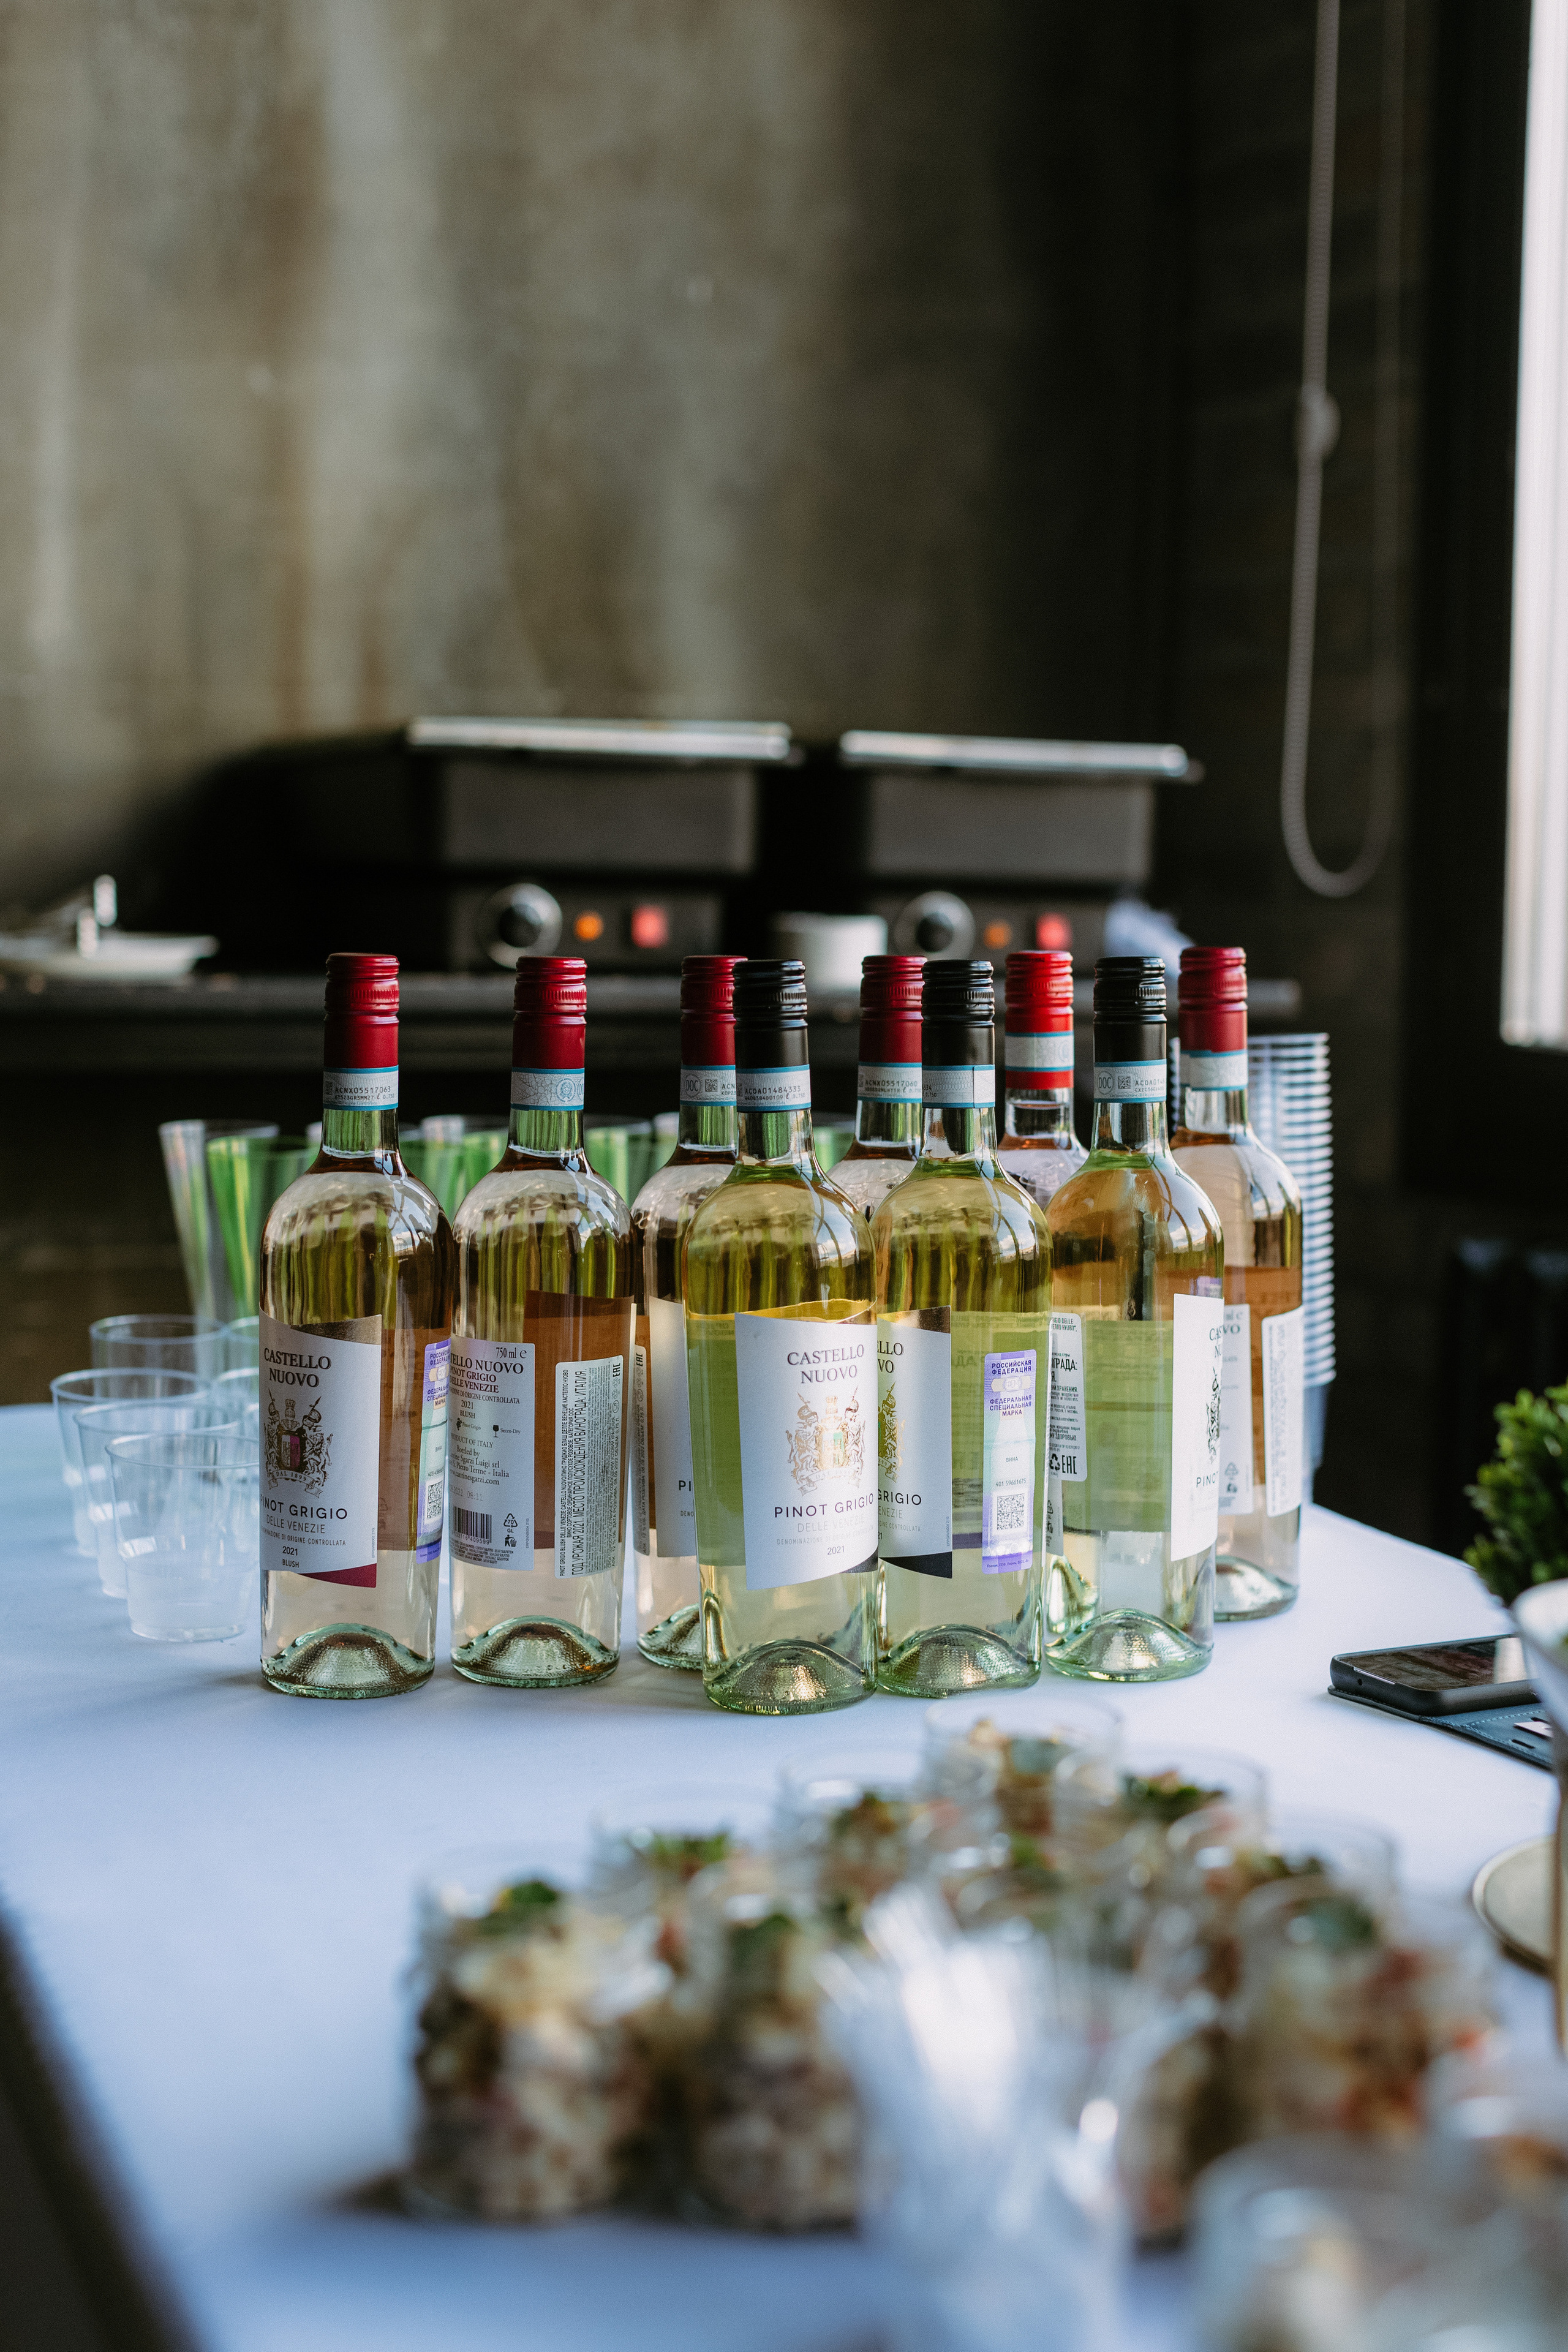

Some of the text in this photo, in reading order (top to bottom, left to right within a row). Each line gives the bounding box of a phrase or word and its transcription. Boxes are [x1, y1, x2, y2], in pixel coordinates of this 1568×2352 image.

[686, 1080, 698, 1091] DOC
[1098, 1077, 1112, 1089] DOC
[1223, 1324, 1241, 1335] VO
[264, 1347, 331, 1370] CASTELLO
[496, 1347, 507, 1359] 750
[508, 1347, 517, 1359] ml
[787, 1344, 864, 1366] CASTELLO
[451, 1352, 524, 1374] TELLO NUOVO
[877, 1359, 894, 1373] VO
[992, 1360, 1031, 1370] РОССИЙСКАЯ
[1052, 1357, 1077, 1373] ГРАДА:
[467, 1370, 497, 1383] GRIGIO
[801, 1365, 858, 1384] NUOVO
[992, 1365, 1031, 1376] ФЕДЕРАЦИЯ
[270, 1367, 319, 1388] NUOVO
[464, 1380, 499, 1393] VENEZIE
[464, 1391, 482, 1401] ORIGINE
[482, 1394, 521, 1404] CONTROLLATA
[990, 1395, 1032, 1405] ФЕДЕРАЛЬНАЯ
[461, 1400, 474, 1409] 2021
[990, 1401, 1032, 1411] СПЕЦИАЛЬНАЯ
[460, 1410, 476, 1419] BLUSH
[469, 1438, 477, 1446] OF
[477, 1439, 494, 1449] ITALY
[456, 1444, 480, 1459] Bottled by
[460, 1454, 474, 1464] Sgarzi
[475, 1457, 491, 1469] Luigi
[291, 1472, 307, 1482] 1899
[469, 1464, 487, 1476] Terme
[492, 1469, 510, 1478] Italia
[571, 1369, 589, 1575] ГОД УРОЖАЯ 2021. МЕСТО ПРОИСХОЖДЕНИЯ ВИНОГРАДА: ИТАЛИЯ.
[679, 1480, 692, 1491] PI
[878, 1488, 922, 1506] GRIGIO
[774, 1493, 874, 1518] PINOT GRIGIO
[289, 1504, 347, 1520] GRIGIO
[878, 1506, 903, 1519] ENEZIE
[266, 1514, 326, 1534] DELLE VENEZIE
[797, 1521, 828, 1533] DELLE
[889, 1522, 922, 1532] CONTROLLATA
[287, 1535, 306, 1544] ORIGINE
[470, 1536, 489, 1545] 409599
[777, 1536, 823, 1545] DENOMINAZIONE
[282, 1545, 298, 1556] 2021
[827, 1545, 845, 1556] 2021
[282, 1559, 300, 1569] BLUSH
